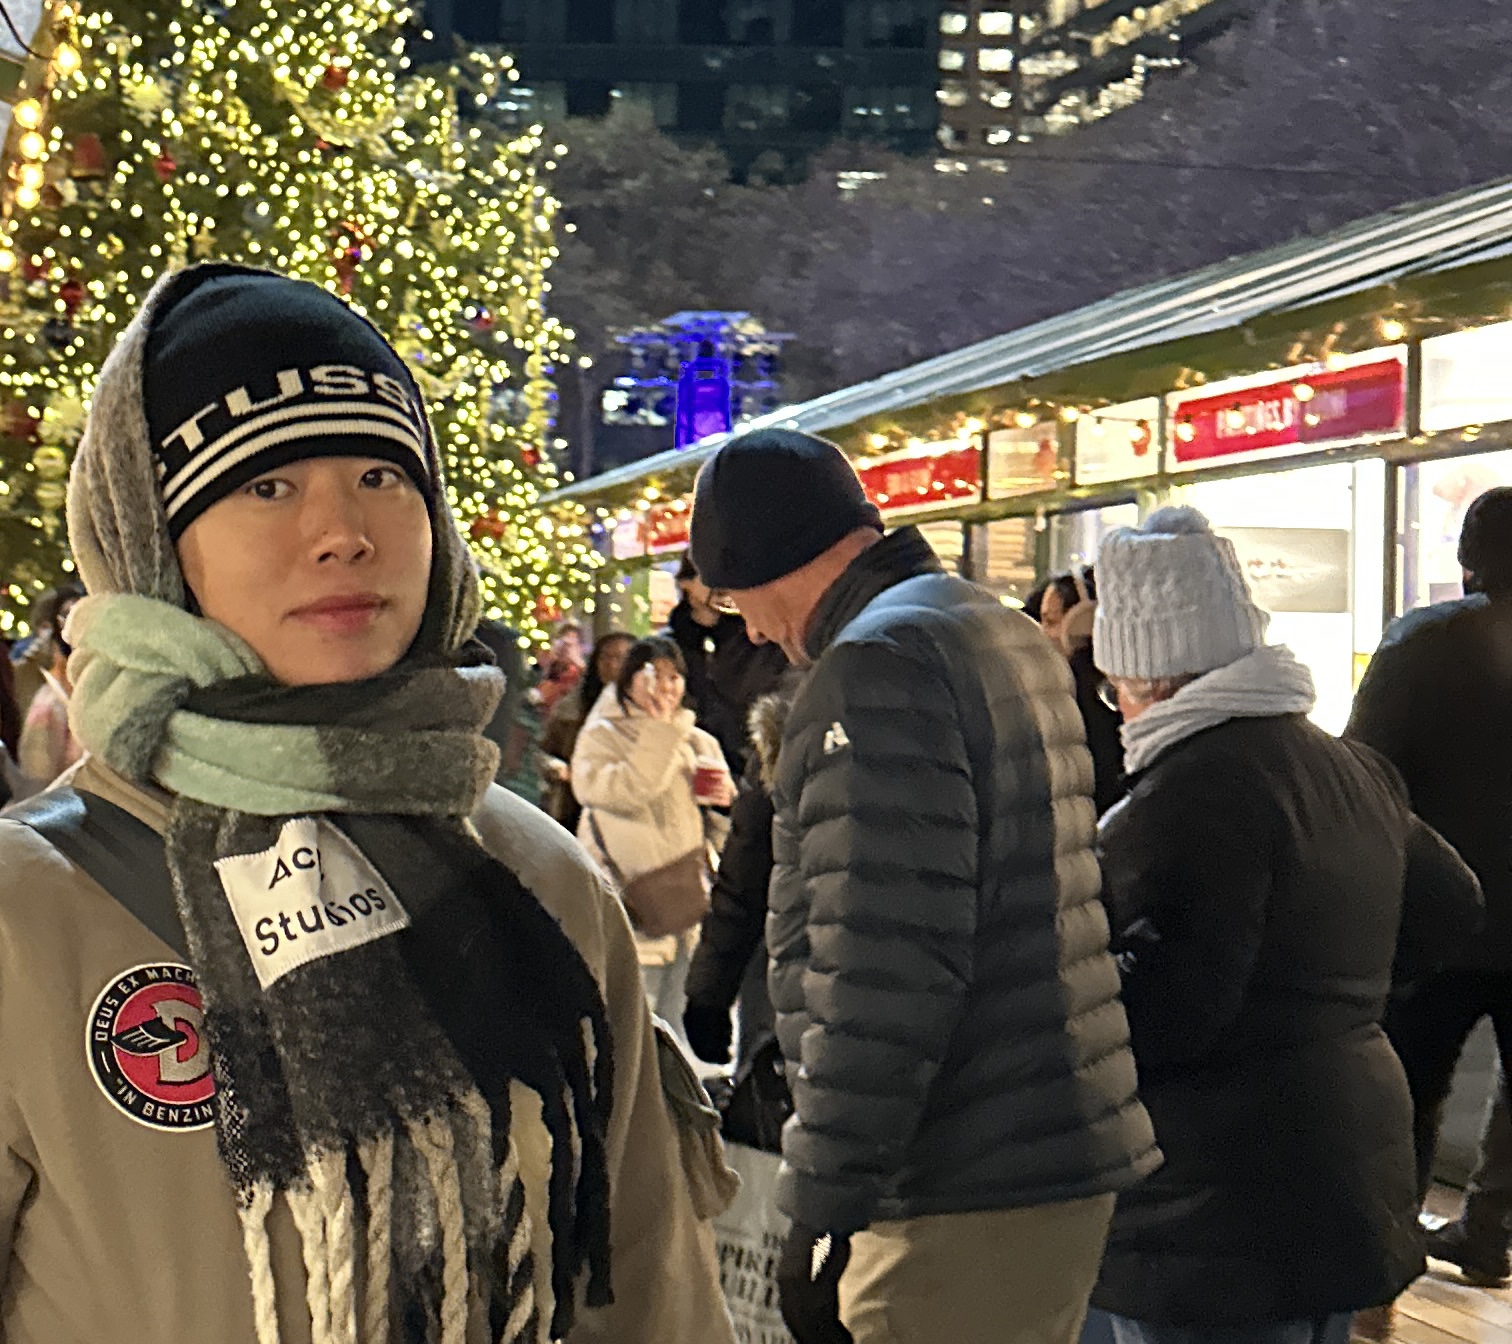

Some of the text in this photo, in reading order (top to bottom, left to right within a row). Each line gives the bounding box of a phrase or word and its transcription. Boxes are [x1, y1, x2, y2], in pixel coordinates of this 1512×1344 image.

[155, 364, 424, 482] TUSS
[268, 846, 326, 891] Ac
[95, 967, 198, 1042] DEUS EX MACH
